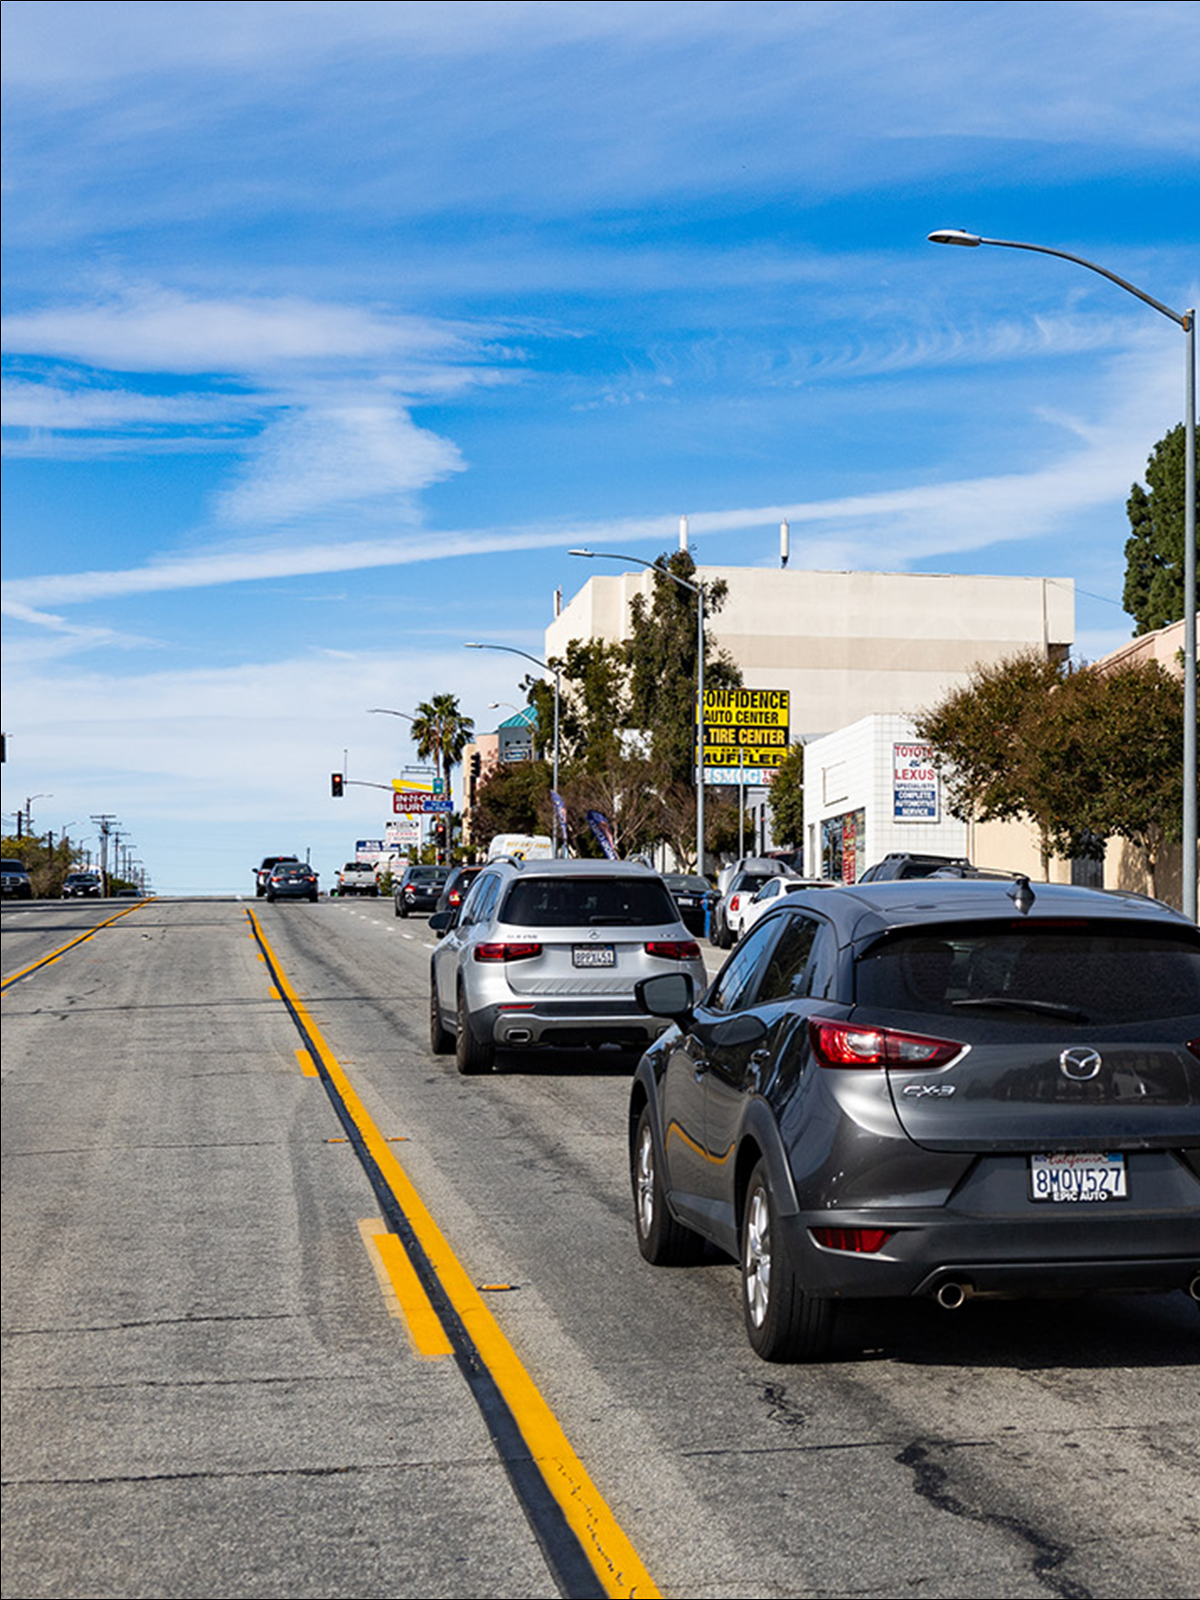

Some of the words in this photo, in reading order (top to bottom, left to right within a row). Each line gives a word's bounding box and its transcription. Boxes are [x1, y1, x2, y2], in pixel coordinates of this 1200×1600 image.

[703, 710, 732, 723] AUTO
[736, 710, 778, 724] CENTER
[709, 728, 736, 744] TIRE
[738, 728, 785, 745] CENTER
[894, 746, 934, 758] TOYOTA
[713, 768, 758, 784] SMOG
[894, 769, 935, 780] LEXUS
[903, 1084, 956, 1097] CX-3
[1047, 1153, 1108, 1168] California
[1036, 1168, 1121, 1193] 8MOV527
[1053, 1192, 1078, 1202] EPIC
[1080, 1191, 1108, 1201] AUTO
